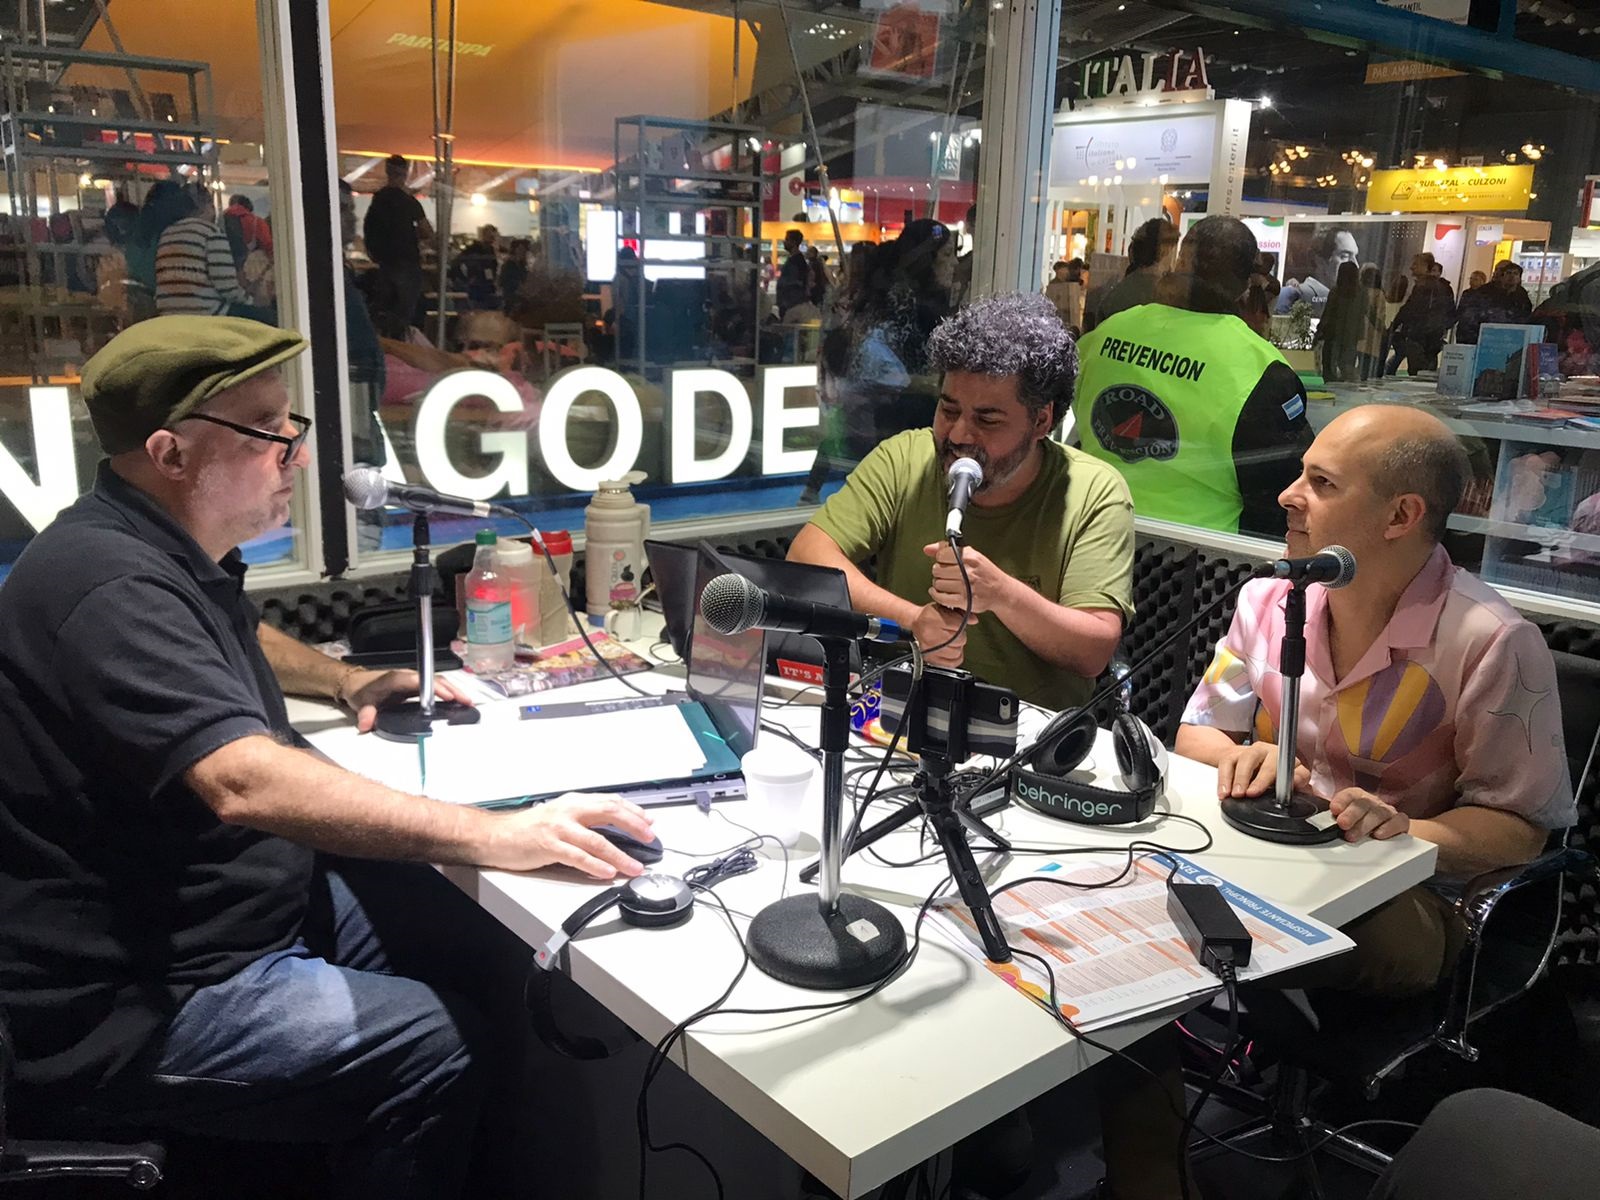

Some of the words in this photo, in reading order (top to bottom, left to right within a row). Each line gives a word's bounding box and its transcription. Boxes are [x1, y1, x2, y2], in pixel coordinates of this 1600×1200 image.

[1079, 46, 1211, 100] ITALIA
[1391, 63, 1433, 77] AMARILLO
[1224, 127, 1240, 218] ires.esteri.it
[1419, 178, 1459, 188] RUBZAL
[1467, 177, 1507, 187] CULZONI
[1258, 239, 1281, 250] ssion
[1100, 337, 1205, 382] PREVENCION
[1103, 388, 1165, 421] ROAD
[374, 366, 643, 502] GO
[671, 365, 820, 485] DE
[782, 666, 812, 681] IT'S
[1018, 778, 1122, 818] behringer
[1221, 887, 1263, 911] PRINCIPAL
[1260, 909, 1316, 938] AUSPICIANTE
